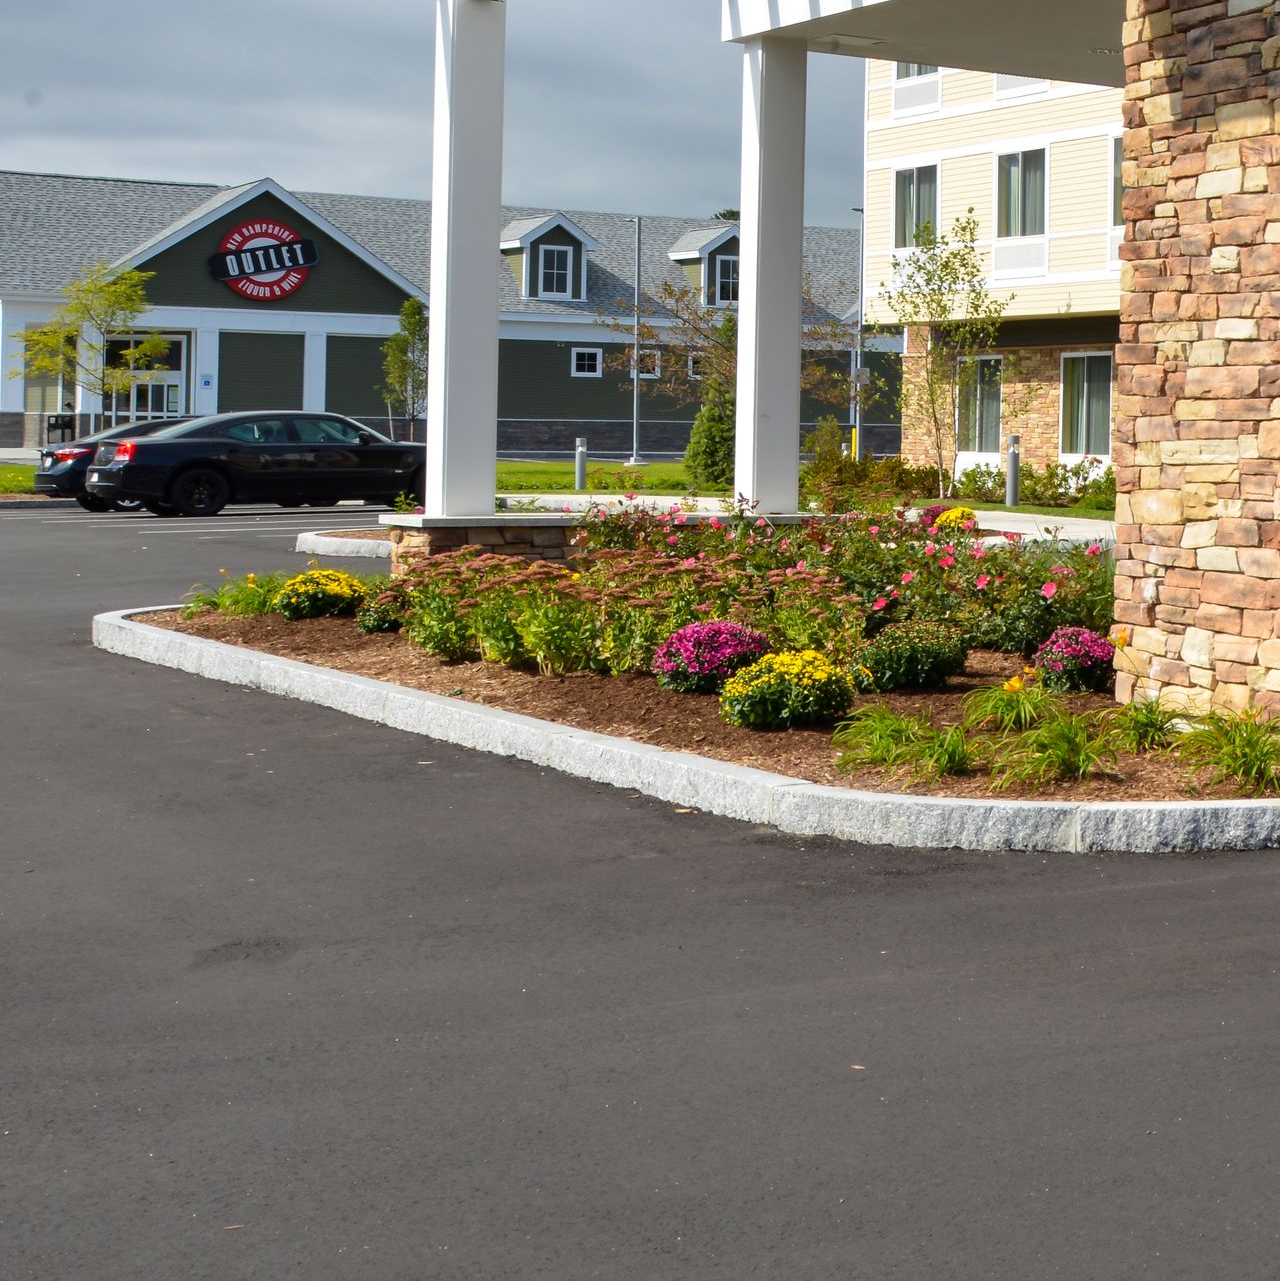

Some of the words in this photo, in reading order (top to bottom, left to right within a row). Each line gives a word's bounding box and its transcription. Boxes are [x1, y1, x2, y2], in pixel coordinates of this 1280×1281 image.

[226, 233, 243, 250] NEW
[242, 223, 294, 241] HAMPSHIRE
[225, 244, 304, 276] OUTLET
[238, 280, 271, 297] LIQUOR
[273, 285, 281, 296] &
[281, 271, 301, 291] WINE
